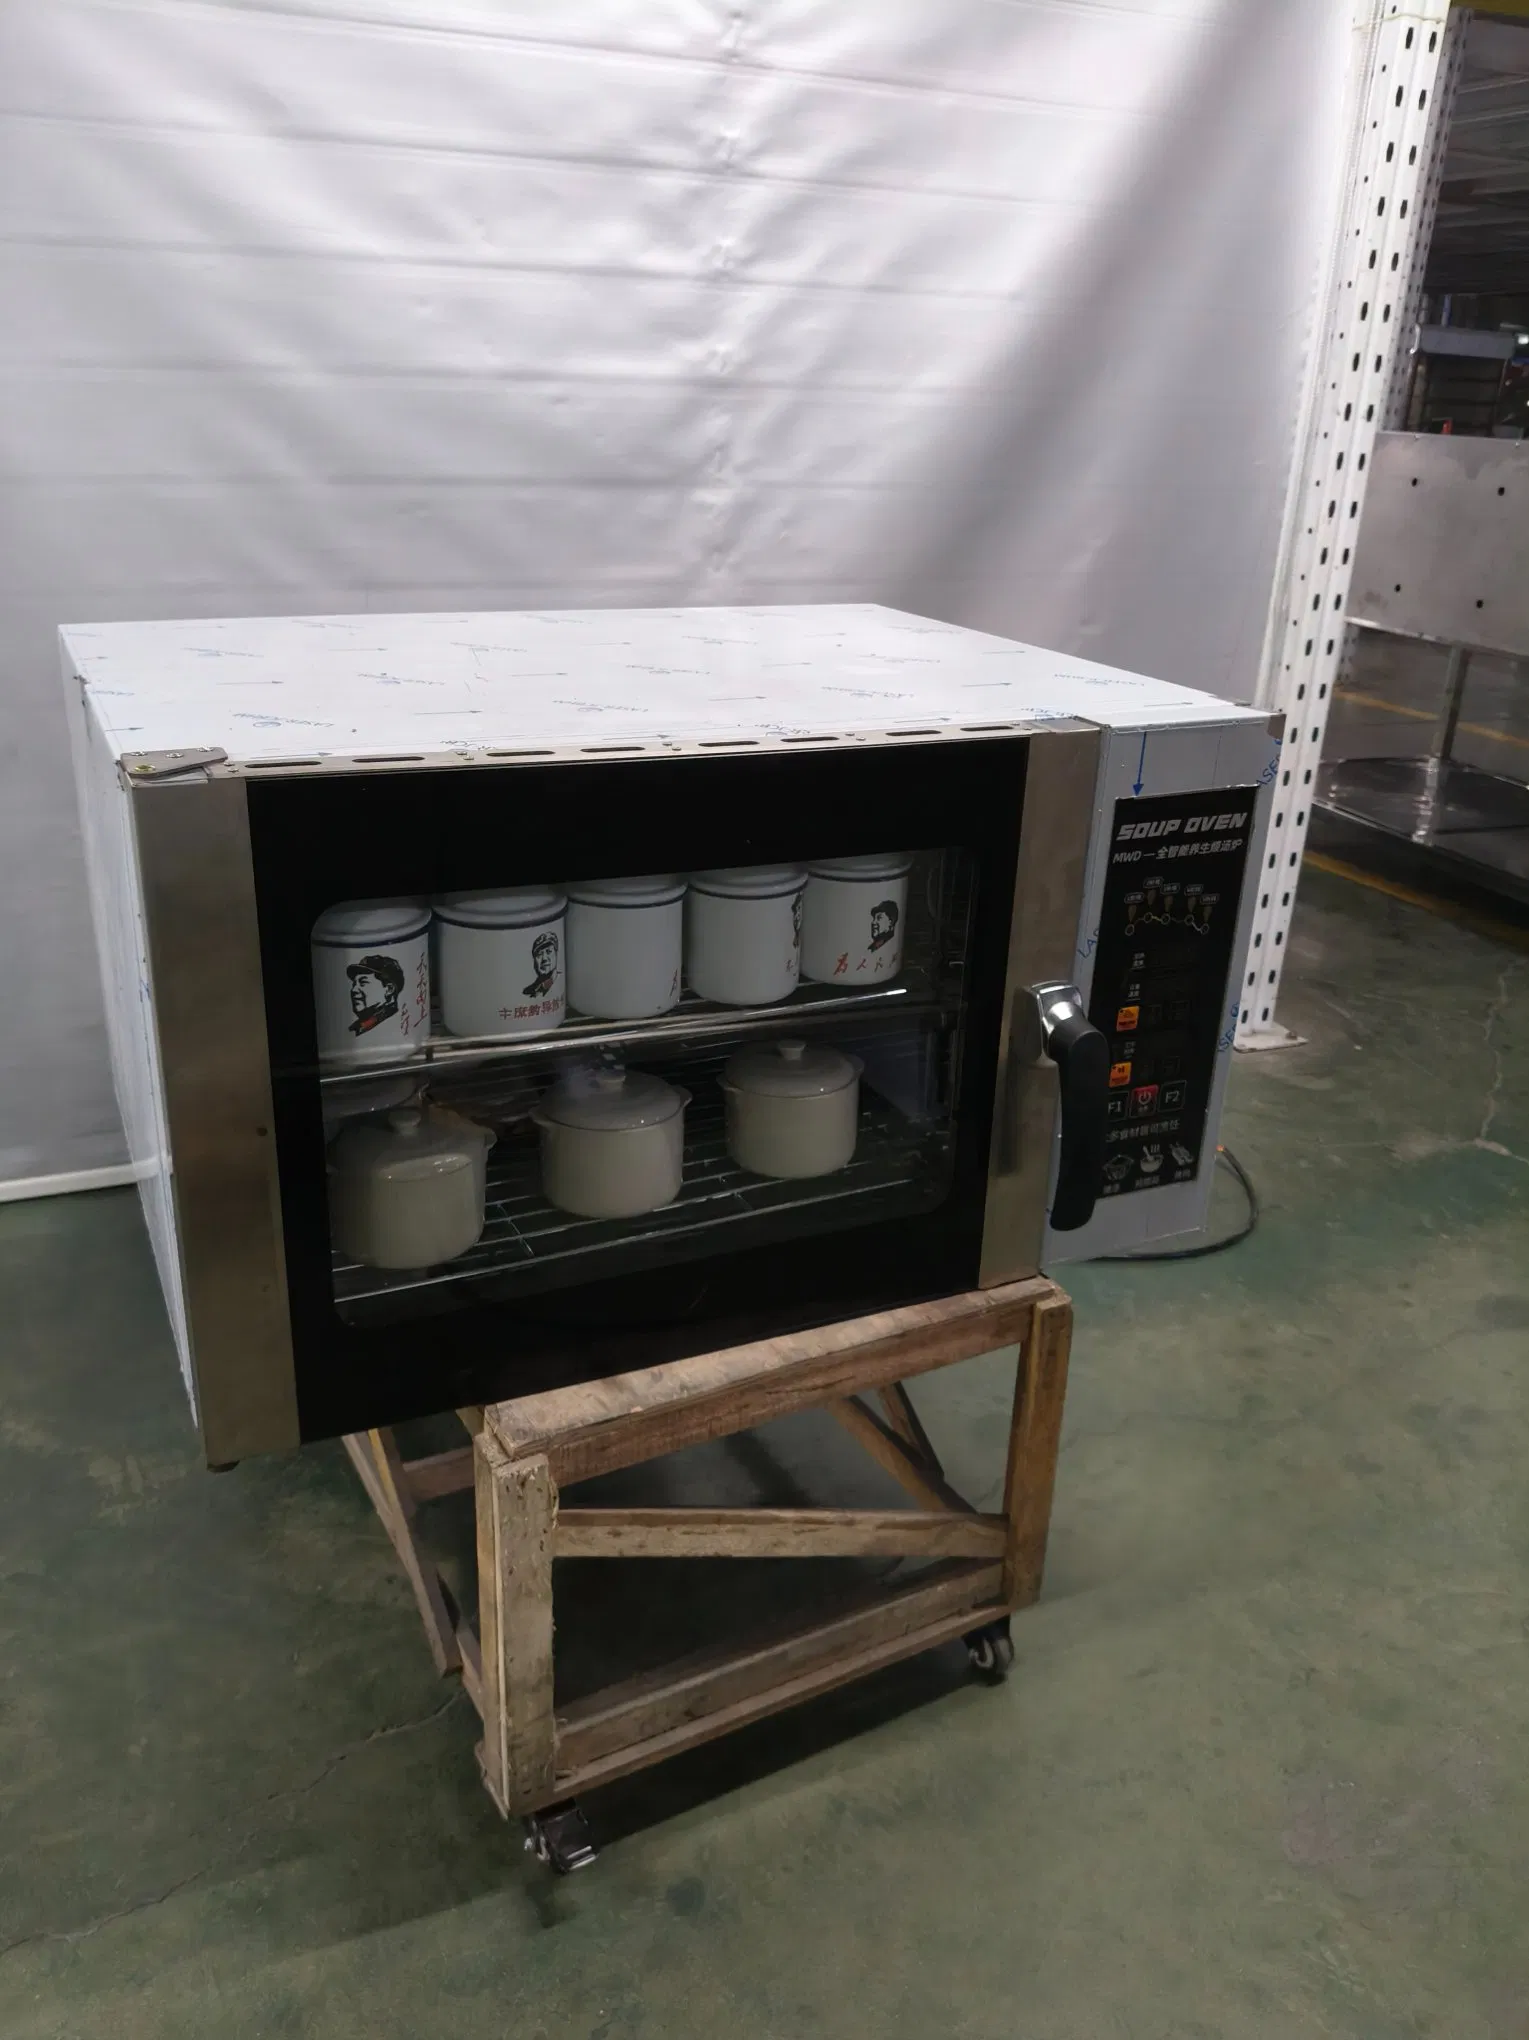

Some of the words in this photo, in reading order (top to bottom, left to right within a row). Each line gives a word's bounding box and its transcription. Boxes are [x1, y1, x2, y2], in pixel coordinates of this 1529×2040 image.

[1116, 819, 1182, 841] SOUP
[1184, 812, 1248, 834] OVEN
[1107, 1101, 1121, 1114] F1
[1165, 1091, 1180, 1104] F2
